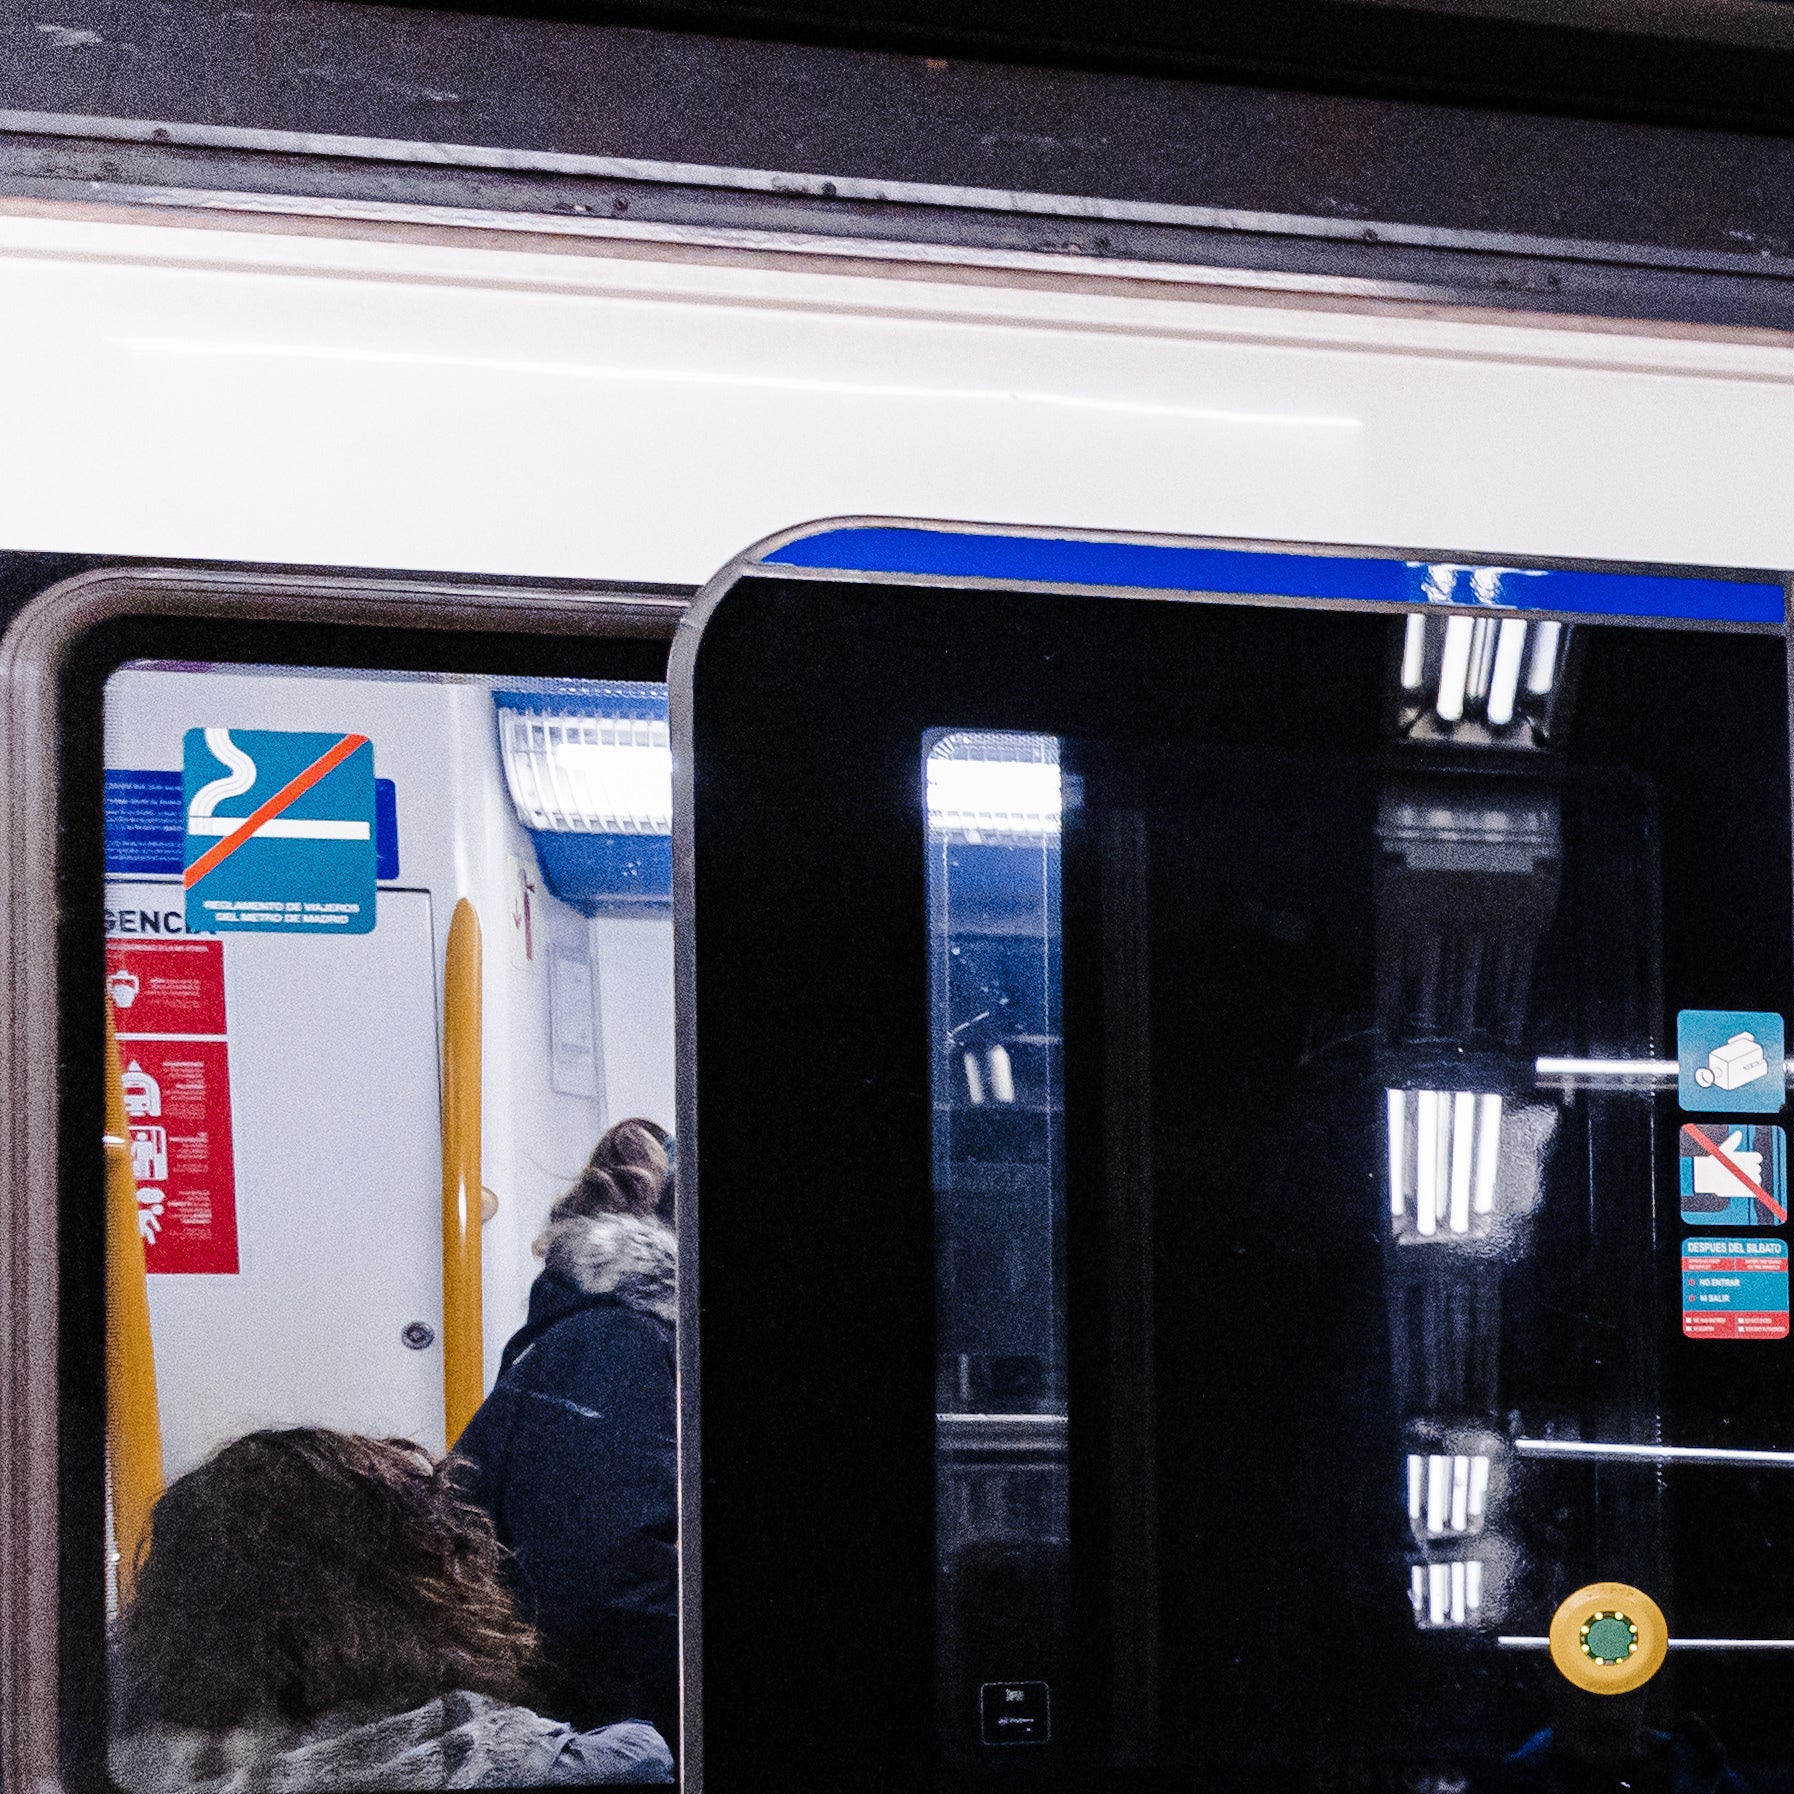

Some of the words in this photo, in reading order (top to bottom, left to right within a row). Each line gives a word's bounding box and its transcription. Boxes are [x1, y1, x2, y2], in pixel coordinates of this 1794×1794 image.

[285, 901, 302, 912] DE
[1687, 1241, 1727, 1253] DESPUES
[1727, 1242, 1745, 1254] DEL
[1746, 1242, 1782, 1255] SILBATO
[1699, 1278, 1710, 1287] NO
[1711, 1278, 1740, 1287] ENTRAR
